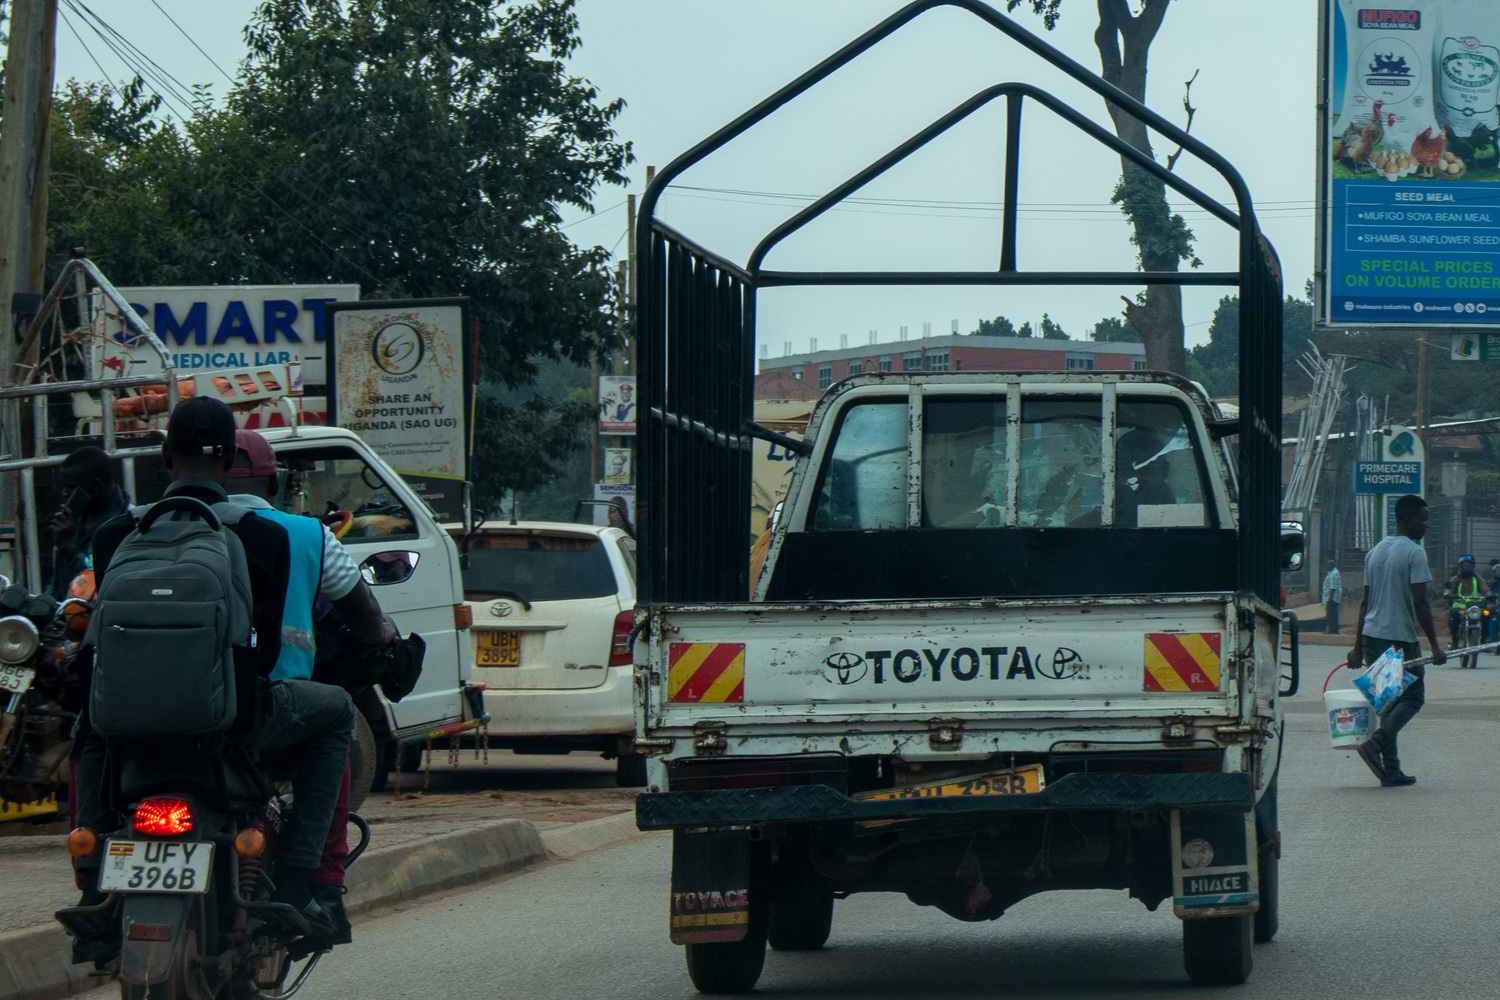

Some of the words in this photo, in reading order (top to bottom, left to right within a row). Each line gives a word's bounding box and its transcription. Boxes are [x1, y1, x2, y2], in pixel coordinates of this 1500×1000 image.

[1361, 10, 1418, 23] MUFIGO
[1395, 192, 1424, 202] SEED
[1426, 193, 1456, 202] MEAL
[1364, 211, 1404, 221] MUFIGO
[1406, 212, 1433, 222] SOYA
[1435, 213, 1463, 222] BEAN
[1464, 213, 1493, 223] MEAL
[1363, 233, 1407, 243] SHAMBA
[1409, 234, 1471, 245] SUNFLOWER
[1473, 235, 1500, 245] SEED
[1360, 259, 1430, 273] SPECIAL
[1434, 260, 1493, 274] PRICES
[1345, 274, 1369, 288] ON
[1374, 275, 1441, 289] VOLUME
[113, 298, 336, 346] SMART
[162, 352, 249, 369] MEDICAL
[254, 351, 291, 367] LAB
[381, 373, 417, 384] UGANDA
[367, 394, 411, 405] SHARE
[414, 393, 432, 403] AN
[354, 405, 445, 418] OPPORTUNITY
[343, 421, 397, 431] UGANDA
[400, 419, 431, 431] (SAO
[435, 418, 457, 429] UG)
[1360, 464, 1418, 473] PRIMECARE
[1364, 474, 1413, 485] HOSPITAL
[491, 631, 519, 647] UBM
[482, 648, 518, 663] 389C
[864, 646, 1035, 684] TOYOTA
[144, 842, 198, 865] UFY
[128, 865, 196, 890] 396B
[1191, 876, 1242, 893] HIACE
[673, 889, 749, 911] TOYACE
